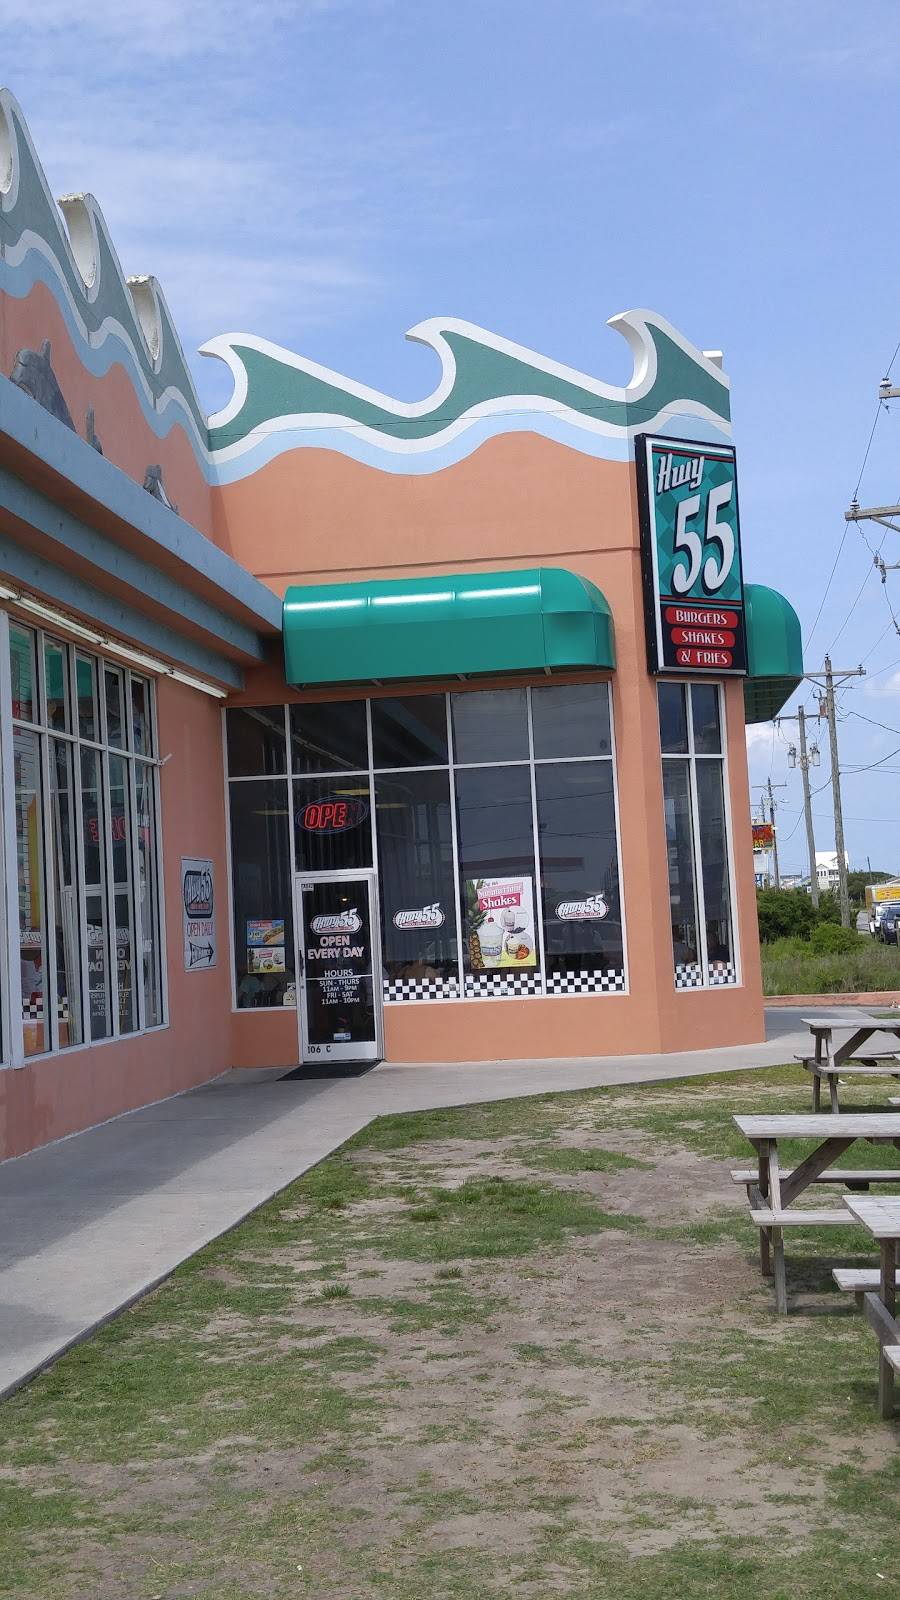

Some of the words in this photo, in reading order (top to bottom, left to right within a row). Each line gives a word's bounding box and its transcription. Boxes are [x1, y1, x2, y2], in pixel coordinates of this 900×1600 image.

[657, 453, 705, 493] Hwy
[672, 480, 735, 595] 55
[676, 610, 728, 625] BURGERS
[681, 630, 725, 645] SHAKES
[681, 649, 691, 663] &
[696, 651, 728, 664] FRIES
[481, 896, 517, 909] Shakes
[585, 894, 604, 912] 55
[337, 908, 358, 926] 55
[421, 903, 440, 921] 55
[320, 935, 350, 947] OPEN
[307, 948, 341, 960] EVERY
[342, 946, 365, 958] DAY
[324, 969, 354, 978] HOURS
[307, 1045, 321, 1054] 106
